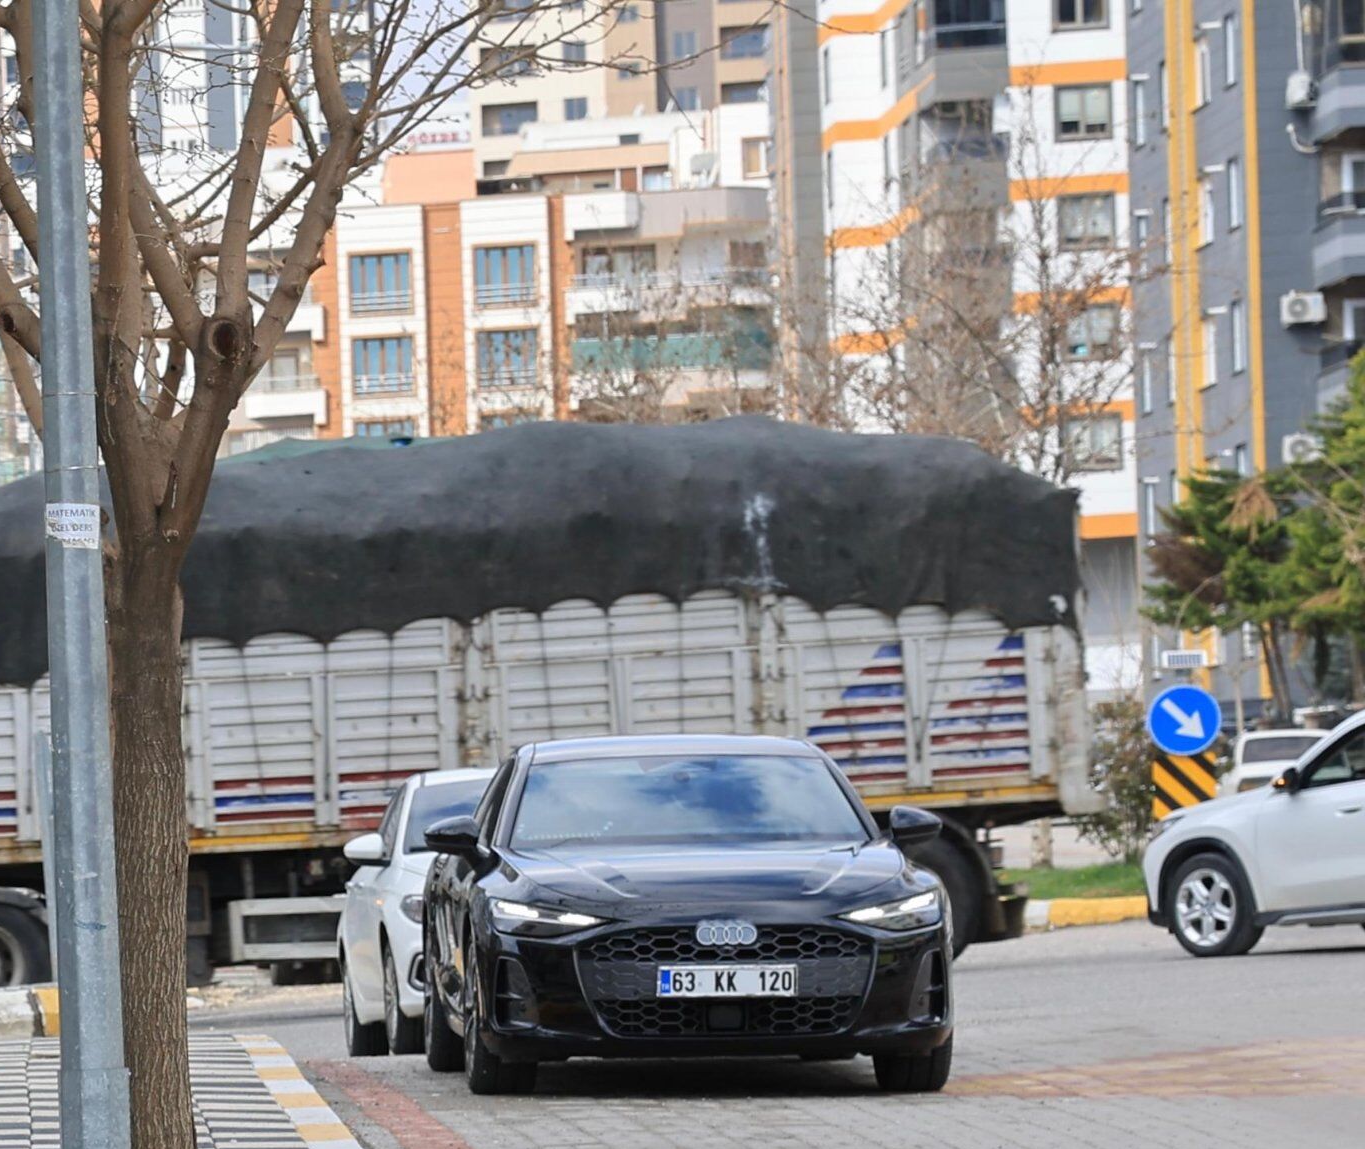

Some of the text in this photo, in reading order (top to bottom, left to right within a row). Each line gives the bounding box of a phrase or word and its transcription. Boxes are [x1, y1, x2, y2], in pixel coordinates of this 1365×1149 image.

[672, 971, 696, 993] 63
[714, 971, 737, 993] KK
[759, 970, 793, 992] 120
